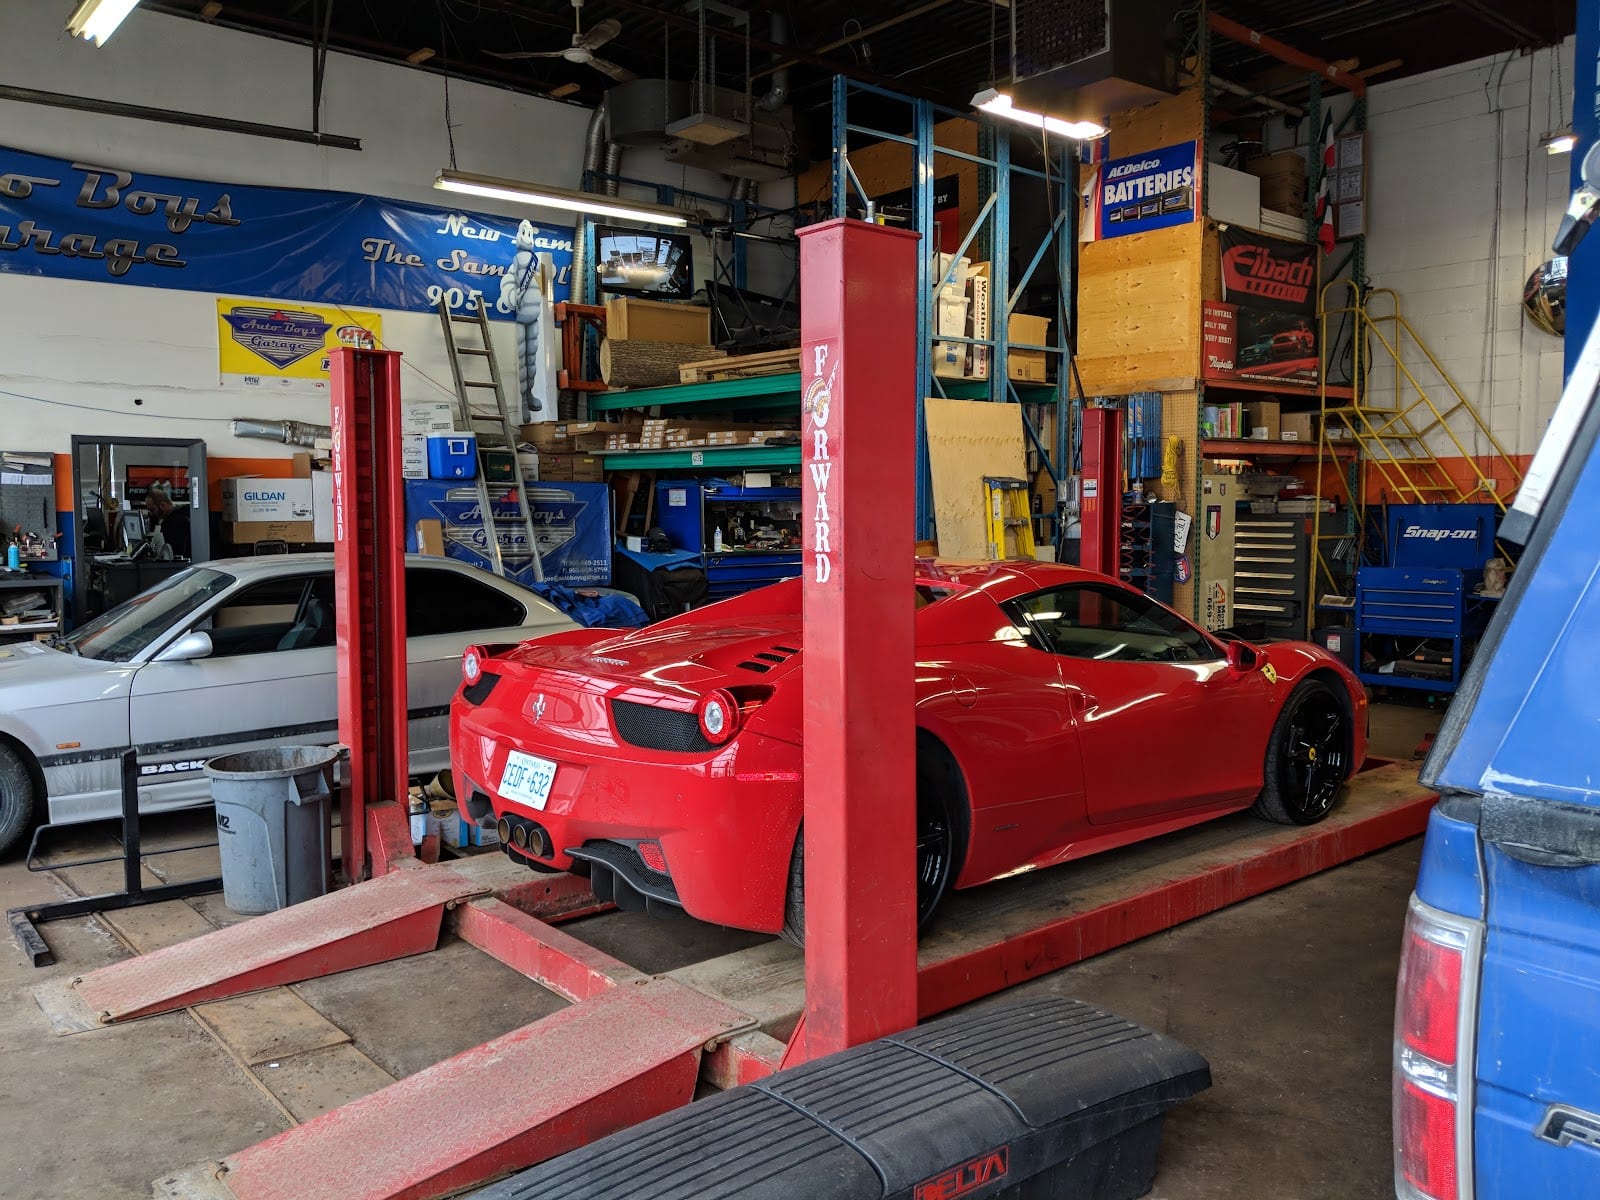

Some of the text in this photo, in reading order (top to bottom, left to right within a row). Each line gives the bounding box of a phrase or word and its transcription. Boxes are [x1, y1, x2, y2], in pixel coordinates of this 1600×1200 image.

[1107, 158, 1161, 179] ACDelco
[71, 162, 241, 233] Boys
[1104, 166, 1193, 205] BATTERIES
[436, 213, 501, 242] New
[361, 237, 425, 267] The
[437, 249, 510, 277] Sam
[1222, 244, 1314, 298] Eibach
[241, 319, 318, 336] Auto Boys
[250, 335, 306, 352] Garage
[808, 344, 832, 583] FORWARD
[244, 491, 285, 501] GILDAN
[458, 505, 518, 520] Ato
[1403, 525, 1477, 541] Snap-on
[503, 762, 529, 789] CEDF
[529, 771, 550, 797] 632
